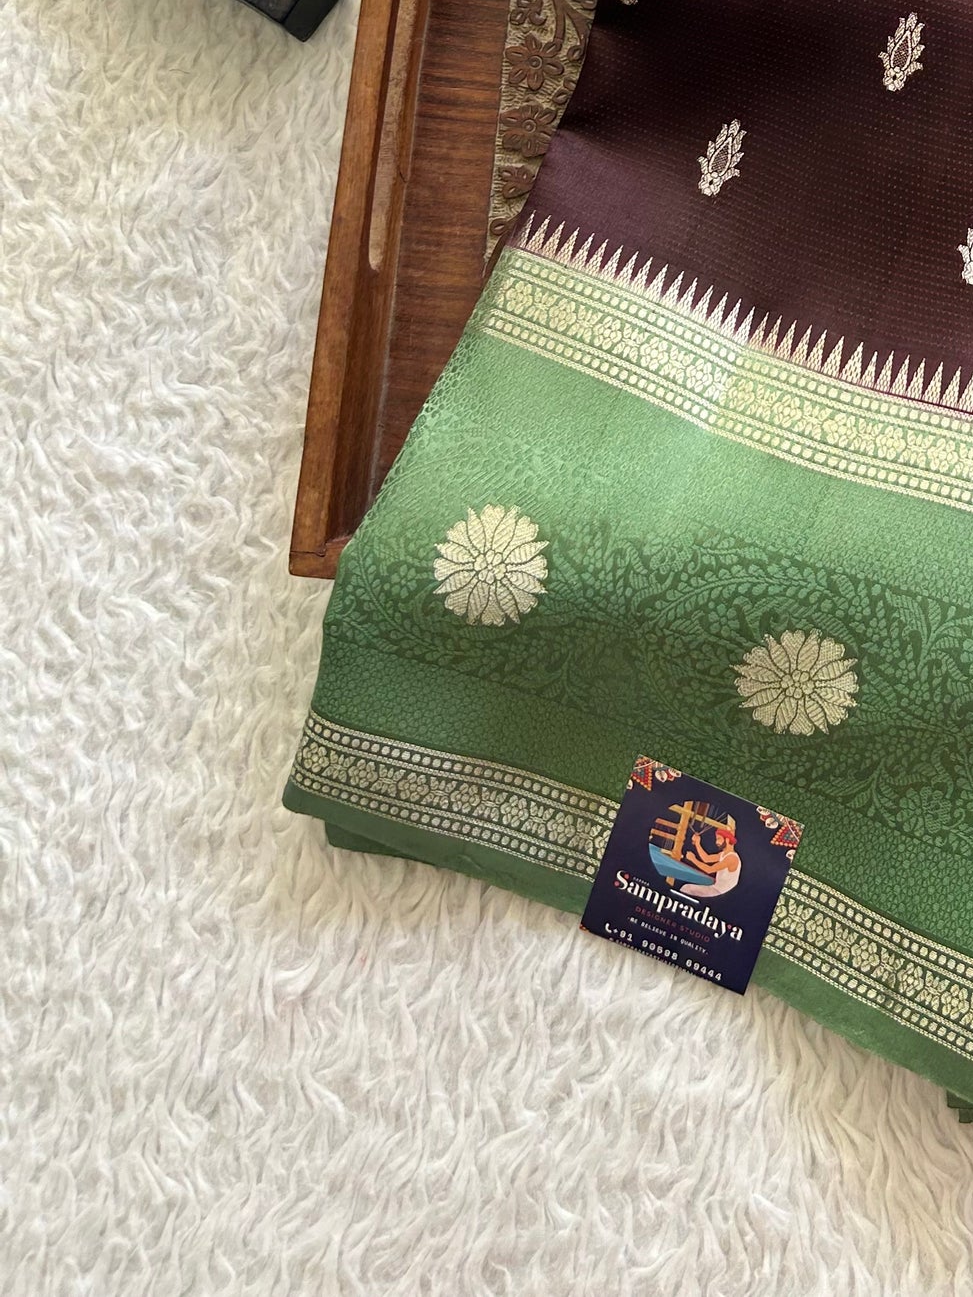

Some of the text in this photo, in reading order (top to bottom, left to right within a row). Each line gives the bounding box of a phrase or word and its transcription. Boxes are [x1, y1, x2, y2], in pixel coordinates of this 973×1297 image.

[614, 869, 743, 941] Sampradaya
[635, 905, 710, 943] DESIGNER STUDIO
[640, 921, 667, 937] BELIEVE
[685, 959, 722, 981] 69444
